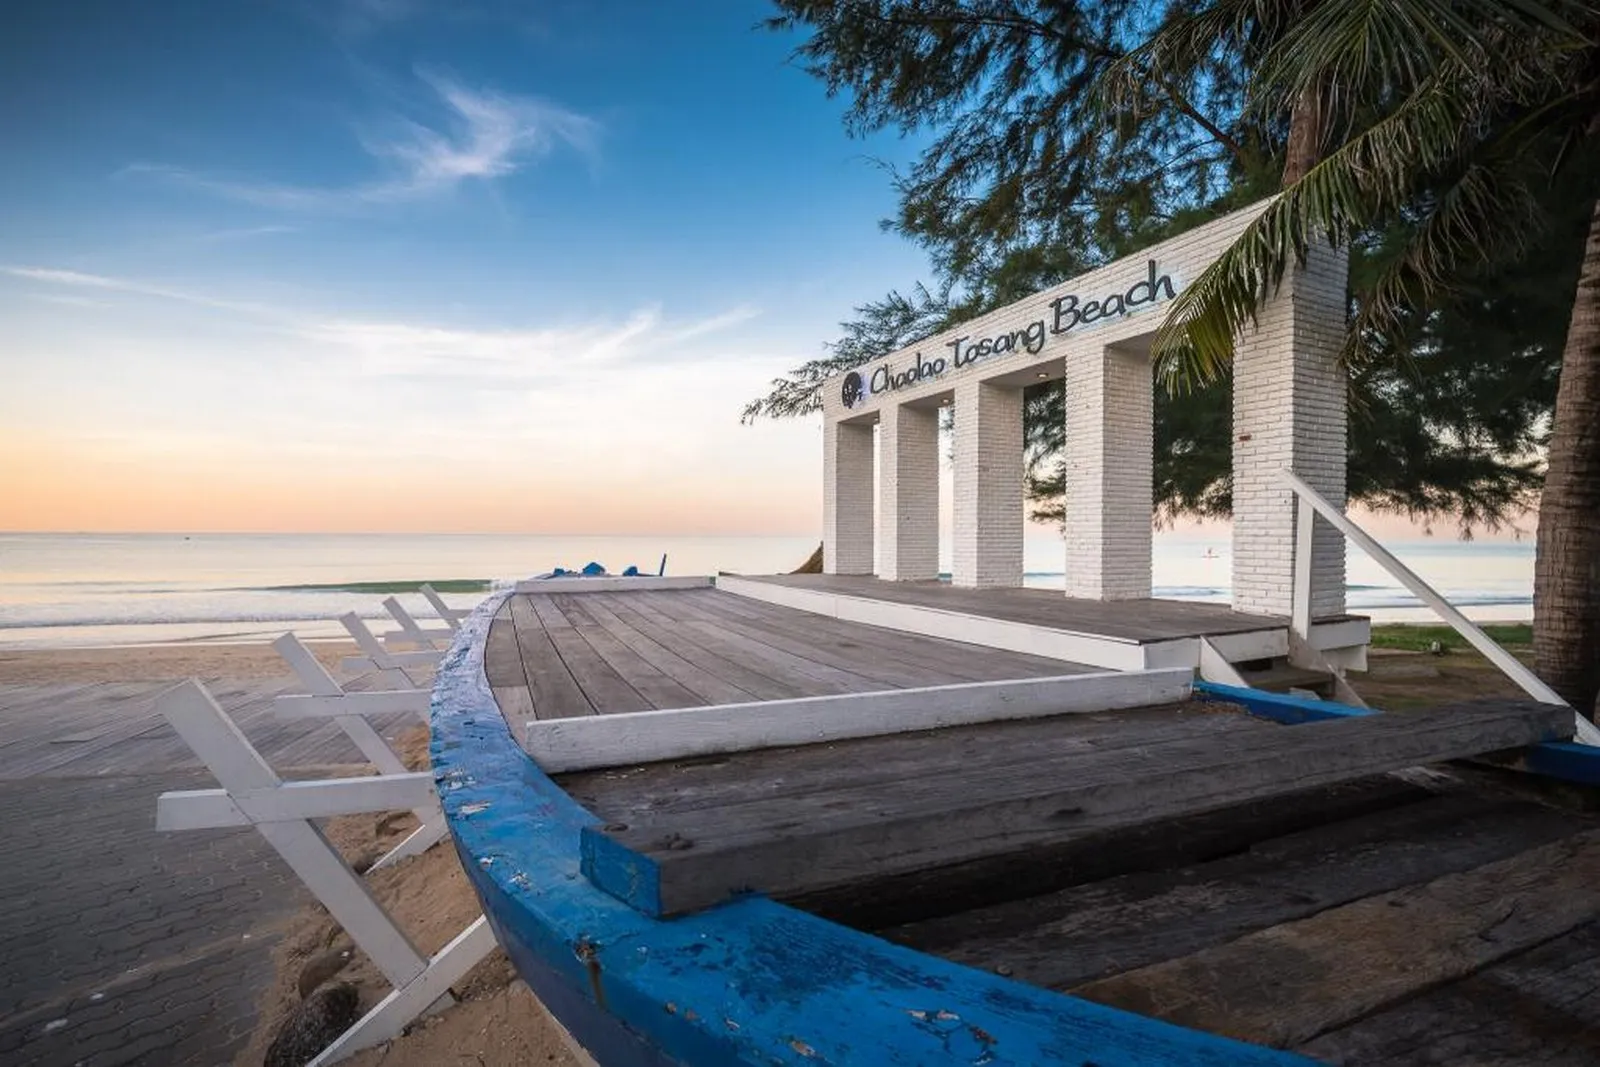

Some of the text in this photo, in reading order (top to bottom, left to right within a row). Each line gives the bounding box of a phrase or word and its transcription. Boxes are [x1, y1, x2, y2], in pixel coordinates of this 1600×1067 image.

[870, 259, 1176, 394] Chaolao Tosang Beach
